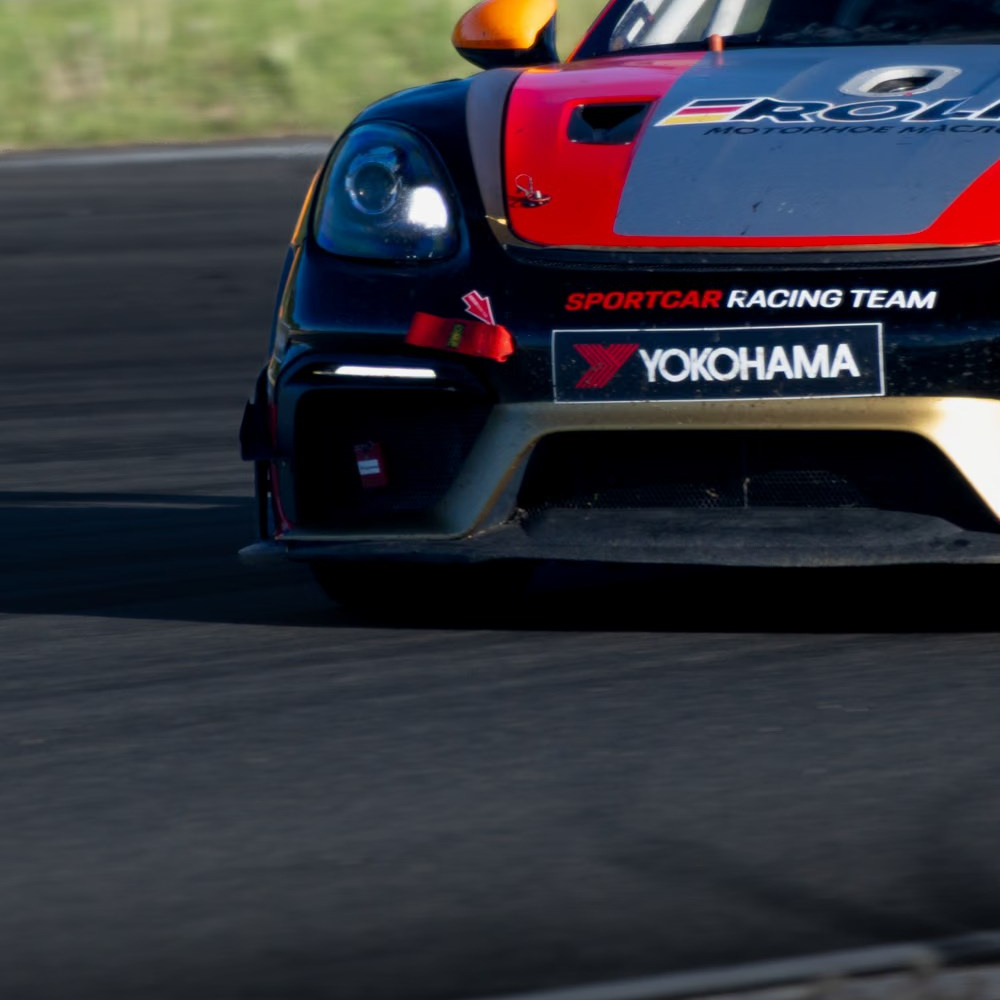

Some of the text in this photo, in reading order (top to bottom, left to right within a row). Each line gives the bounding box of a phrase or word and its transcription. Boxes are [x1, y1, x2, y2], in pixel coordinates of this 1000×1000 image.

[703, 125, 892, 136] МОТОРНОЕ
[564, 289, 938, 311] SPORTCAR RACING TEAM
[638, 343, 861, 383] YOKOHAMA
